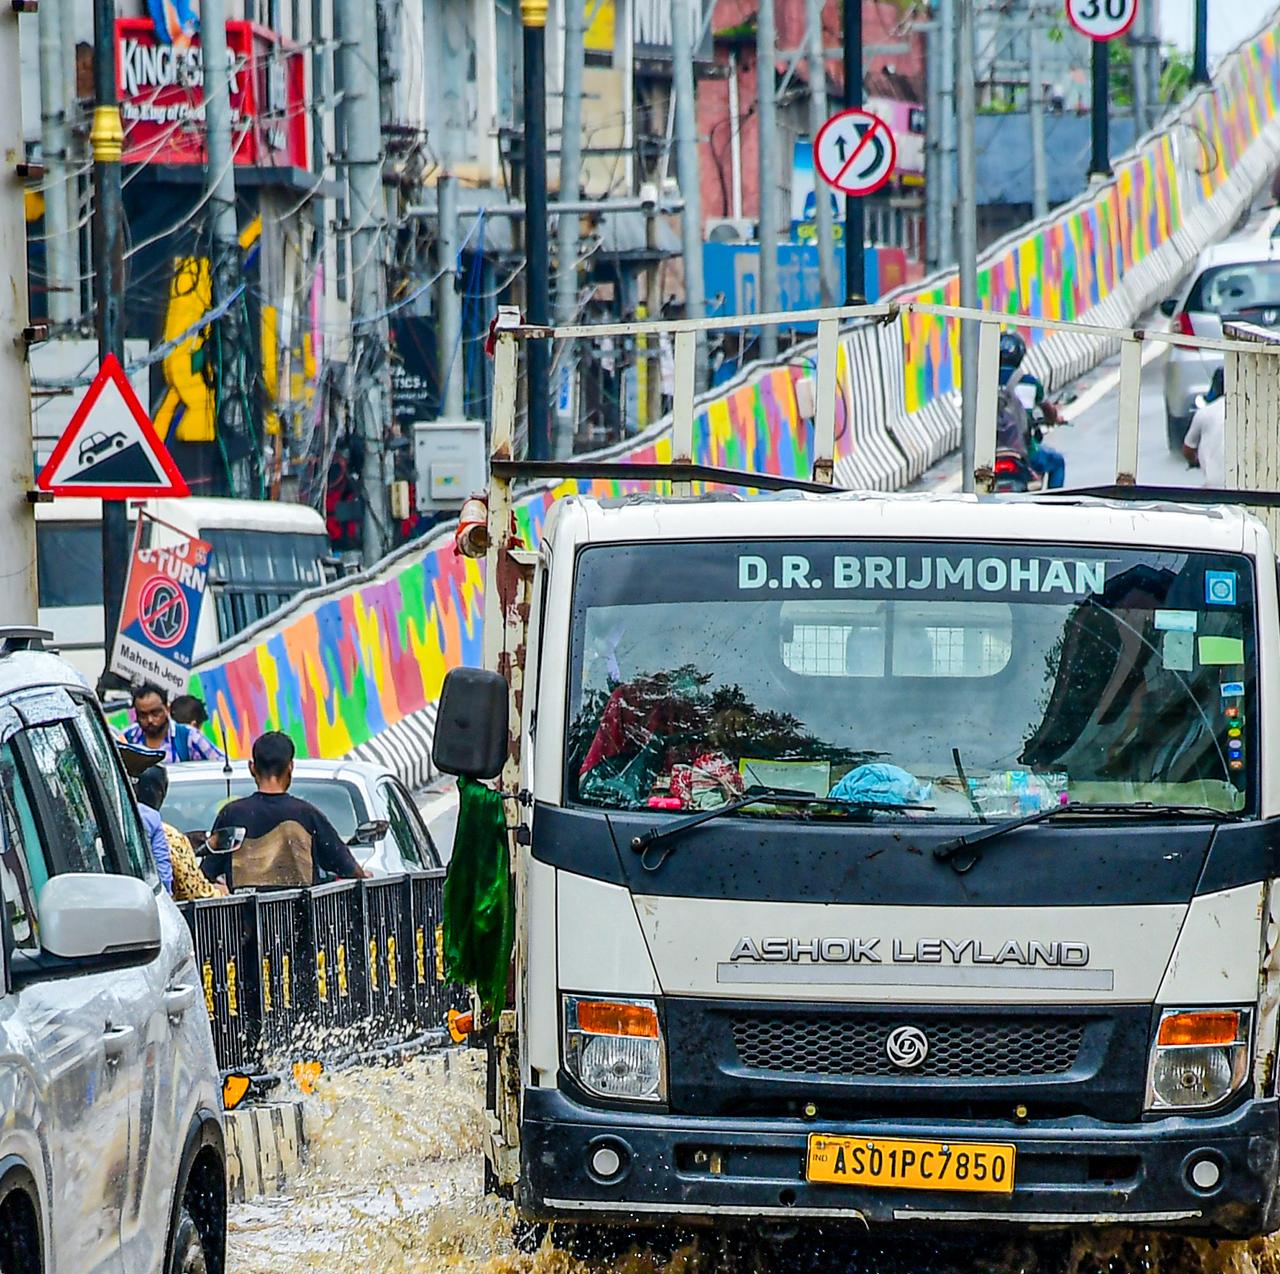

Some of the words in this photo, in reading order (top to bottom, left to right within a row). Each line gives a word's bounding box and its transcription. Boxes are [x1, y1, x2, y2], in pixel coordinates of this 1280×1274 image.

[1080, 0, 1126, 19] 30
[738, 555, 822, 589] D.R.
[833, 555, 1105, 595] BRIJMOHAN
[120, 644, 161, 673] Mahesh
[161, 666, 184, 688] Jeep
[730, 935, 883, 963] ASHOK
[892, 938, 1090, 967] LEYLAND
[833, 1146, 1006, 1183] AS01PC7850
